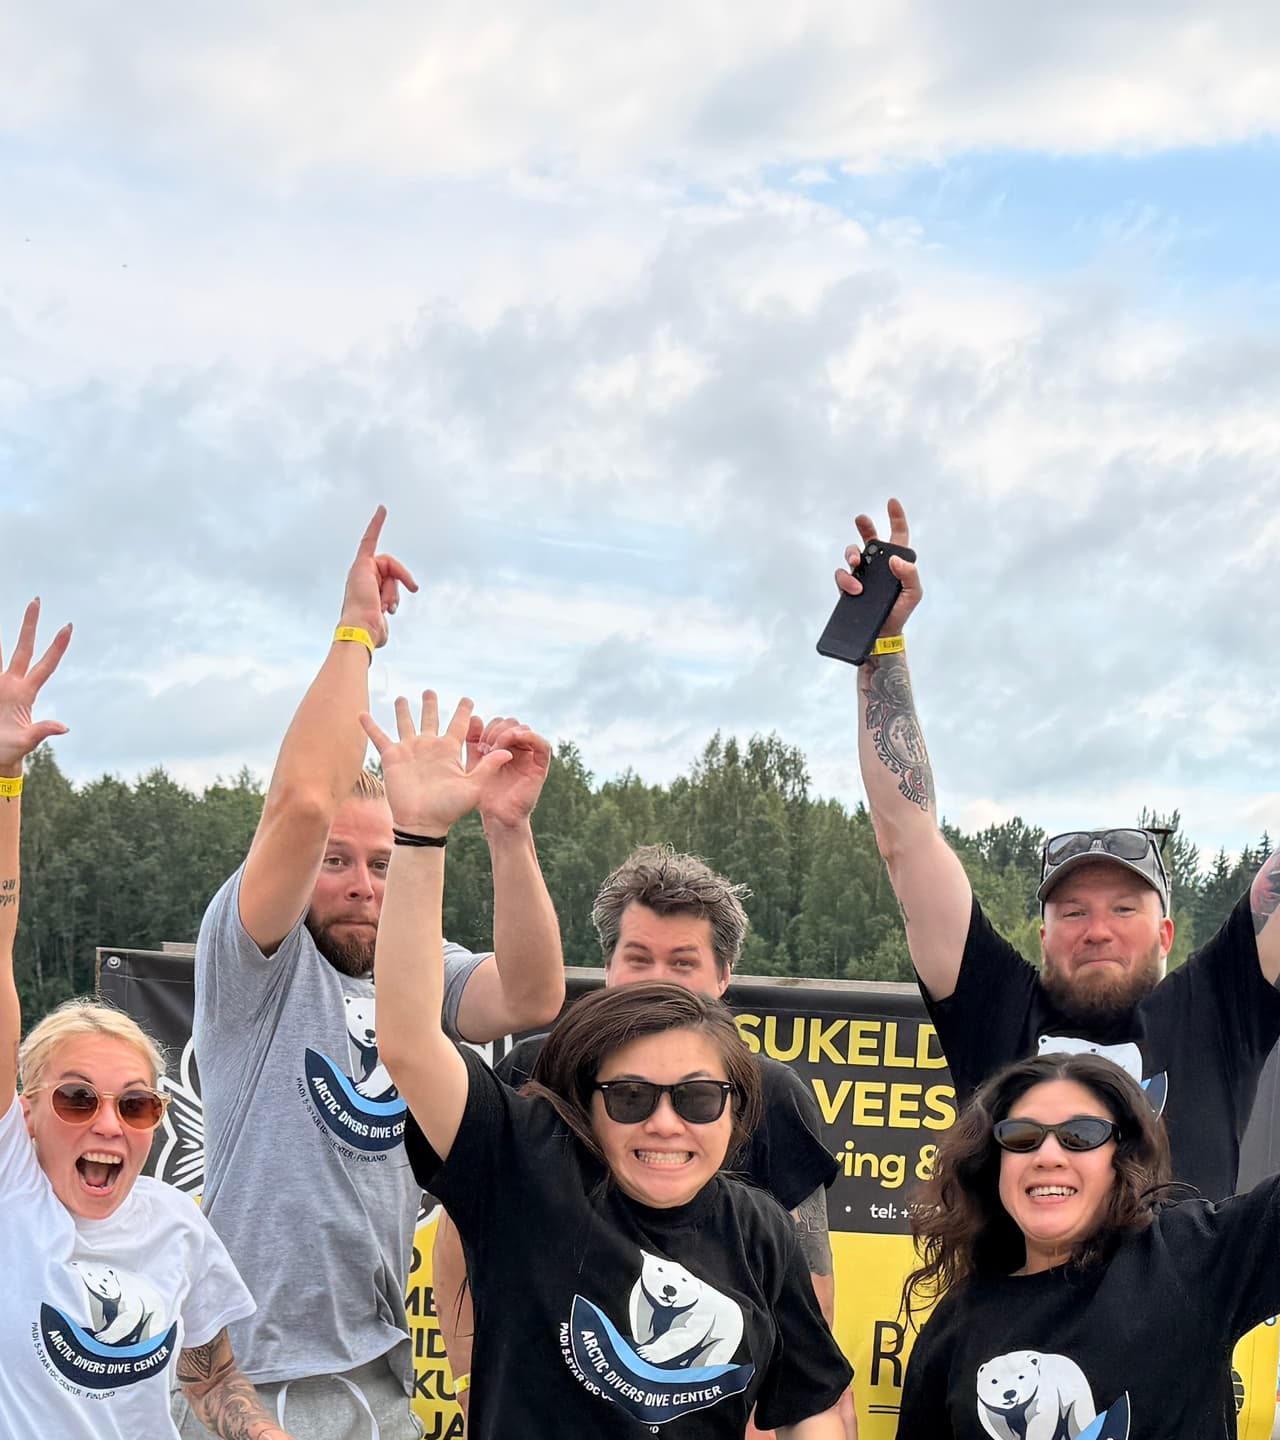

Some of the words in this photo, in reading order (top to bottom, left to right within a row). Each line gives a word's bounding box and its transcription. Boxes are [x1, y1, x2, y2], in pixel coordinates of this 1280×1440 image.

[312, 1077, 341, 1115] ARCTIC
[338, 1111, 369, 1137] DIVERS
[370, 1126, 391, 1139] DIVE
[811, 1079, 958, 1130] VEES
[33, 1343, 51, 1370] 5-STAR
[58, 1378, 82, 1397] CENTER
[48, 1330, 74, 1361] ARCTIC
[73, 1355, 106, 1374] DIVERS
[107, 1363, 131, 1375] DIVE
[134, 1345, 169, 1372] CENTER
[559, 1322, 569, 1347] PADI
[583, 1380, 600, 1396] IDC
[581, 1330, 610, 1374] ARCTIC
[604, 1371, 646, 1404] DIVERS
[645, 1393, 670, 1407] DIVE
[673, 1385, 723, 1406] CENTER
